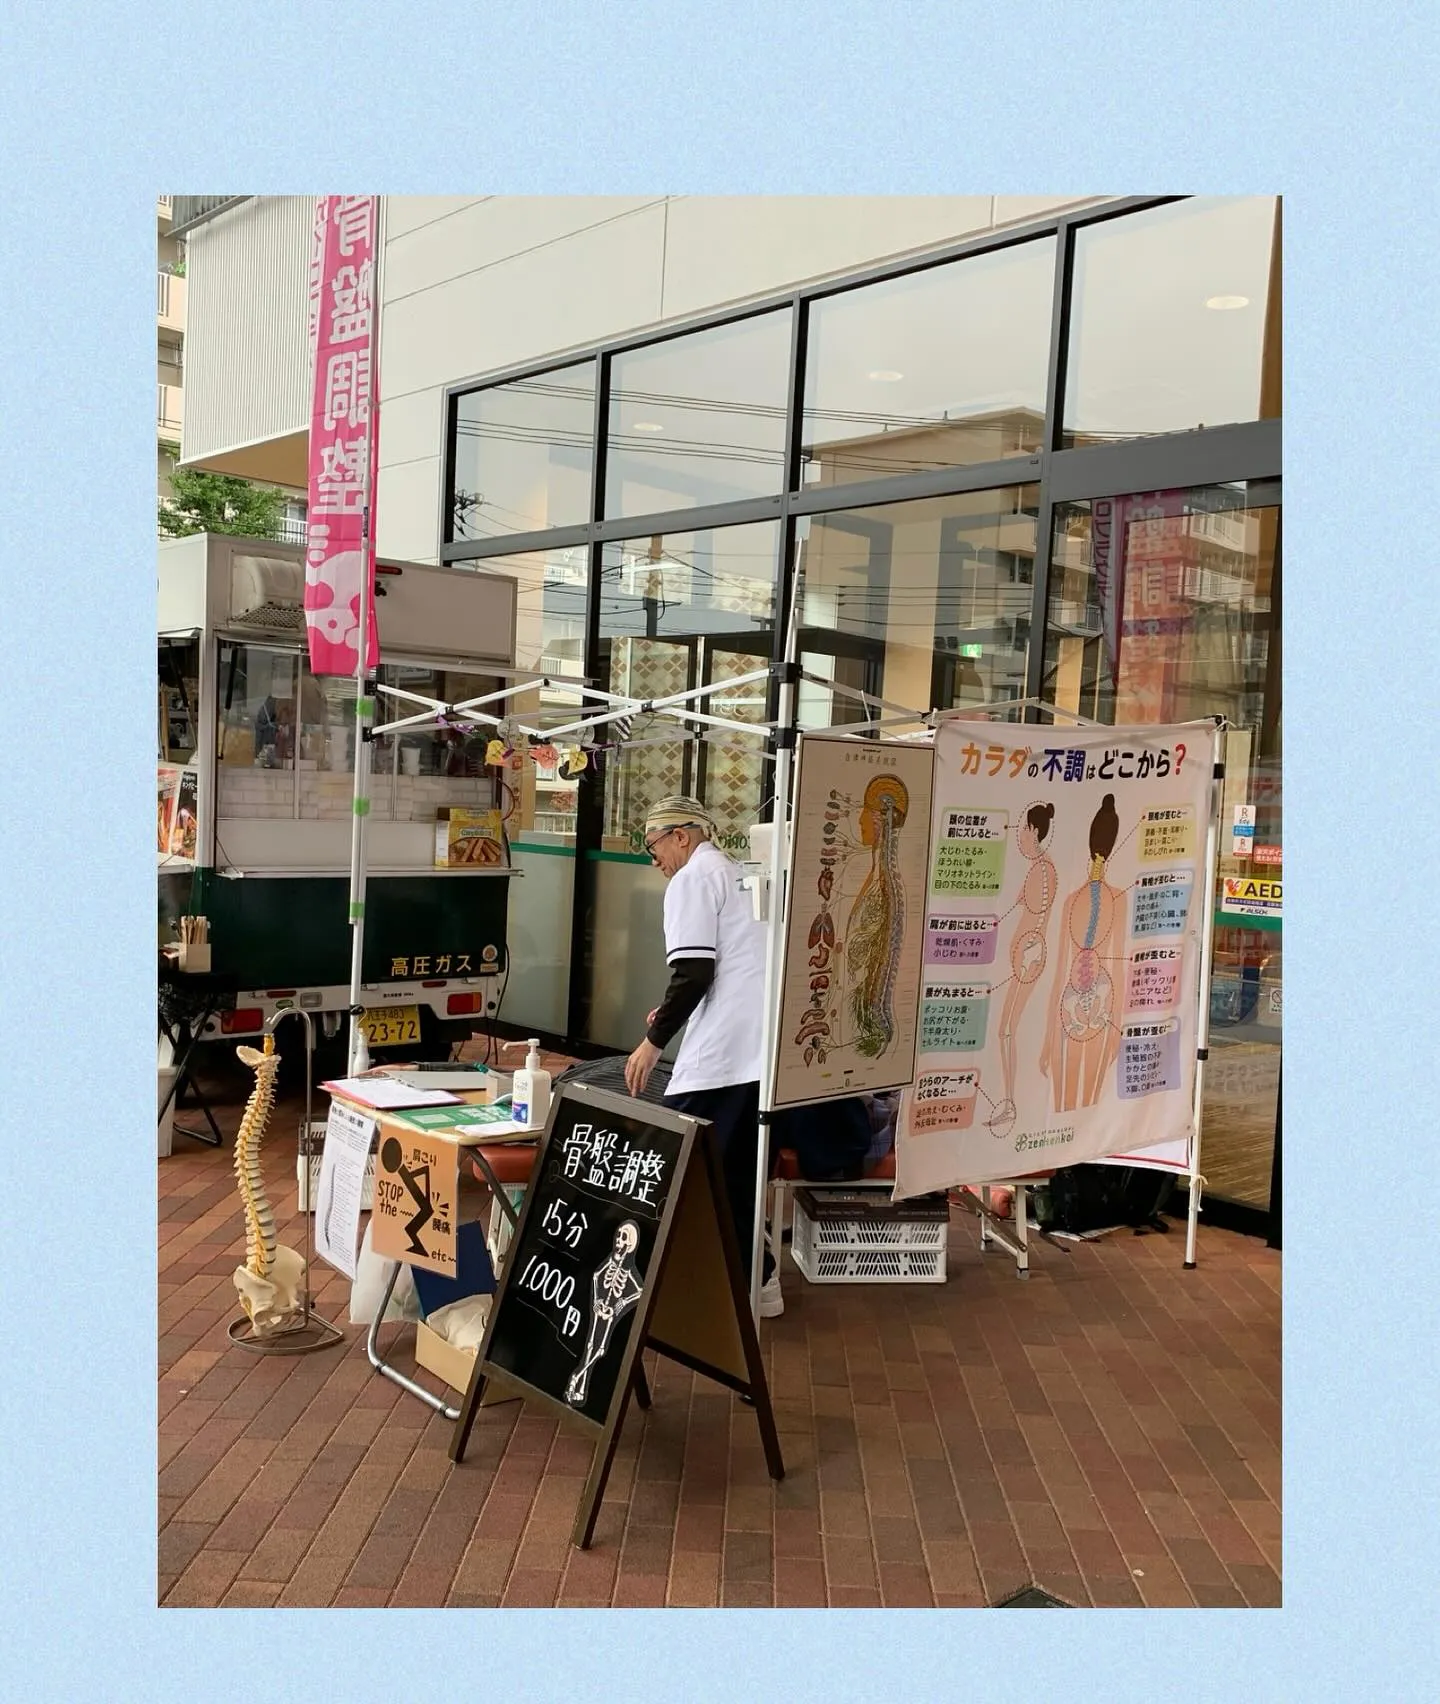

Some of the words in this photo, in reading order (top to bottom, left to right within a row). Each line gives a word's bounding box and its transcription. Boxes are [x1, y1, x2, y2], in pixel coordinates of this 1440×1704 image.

[960, 743, 1187, 782] カラダの不調はどこから?
[1244, 882, 1282, 899] AED
[391, 954, 472, 976] 高圧ガス
[368, 1020, 417, 1043] 23-72
[413, 1148, 437, 1167] 肩こり
[562, 1123, 666, 1207] 骨盤調整
[378, 1180, 404, 1202] STOP
[380, 1198, 397, 1217] the
[542, 1198, 588, 1248] 15分
